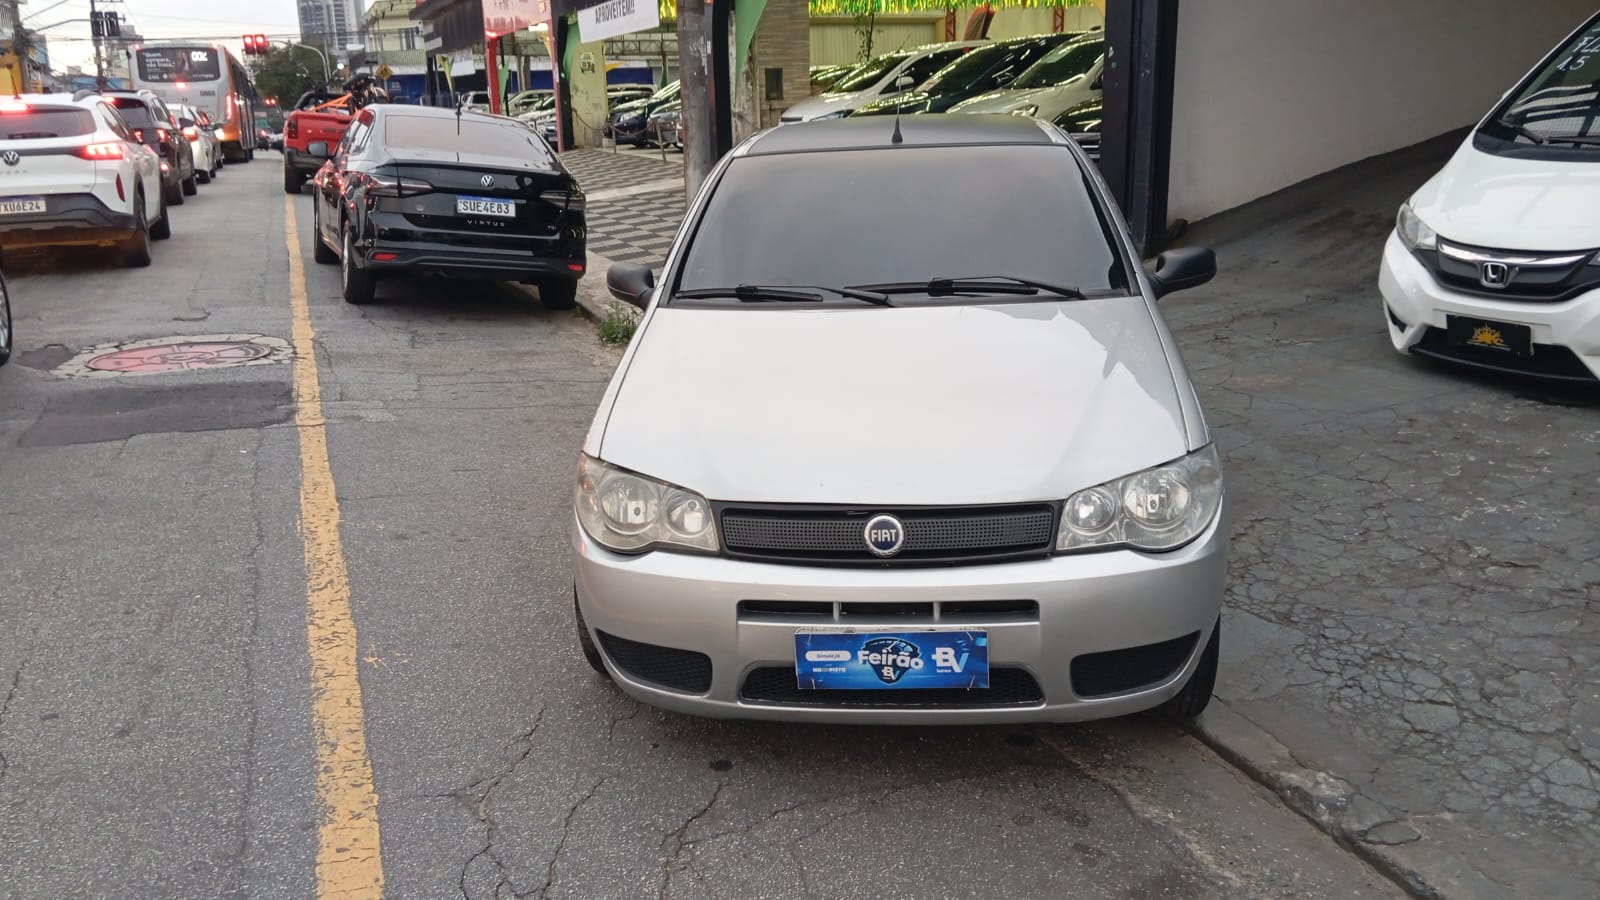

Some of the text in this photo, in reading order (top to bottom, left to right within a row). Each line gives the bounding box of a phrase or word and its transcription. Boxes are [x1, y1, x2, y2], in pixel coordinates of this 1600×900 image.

[462, 200, 510, 215] SUE4E83
[466, 219, 505, 227] VIRTUS
[871, 529, 897, 542] FIAT
[858, 649, 925, 670] Feirão
